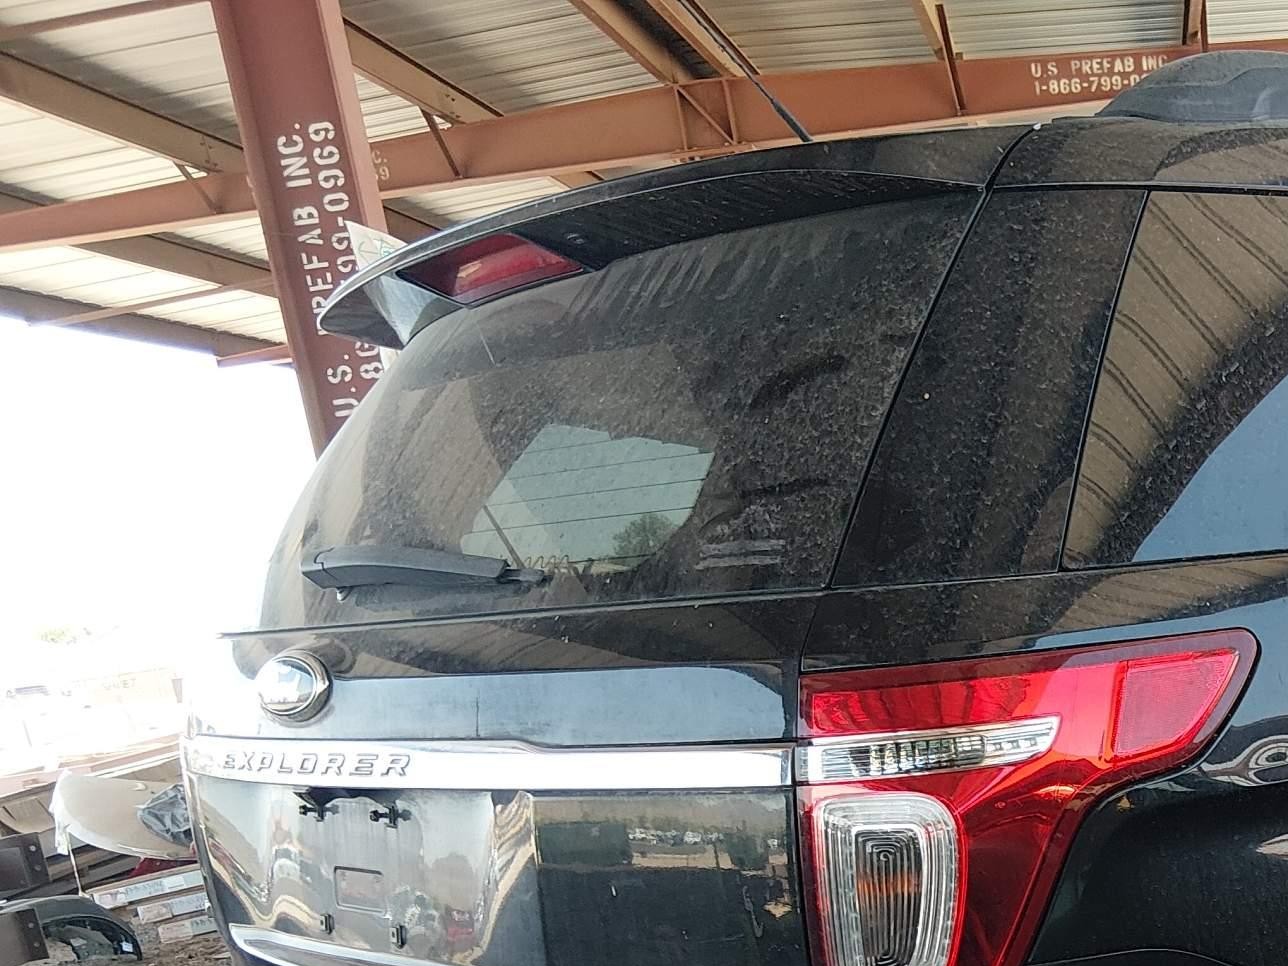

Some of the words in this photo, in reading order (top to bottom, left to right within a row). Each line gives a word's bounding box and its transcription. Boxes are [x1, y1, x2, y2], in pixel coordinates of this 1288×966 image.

[1070, 57, 1135, 75] PREFAB
[277, 122, 313, 188] INC.
[222, 750, 412, 777] EXPLORER
